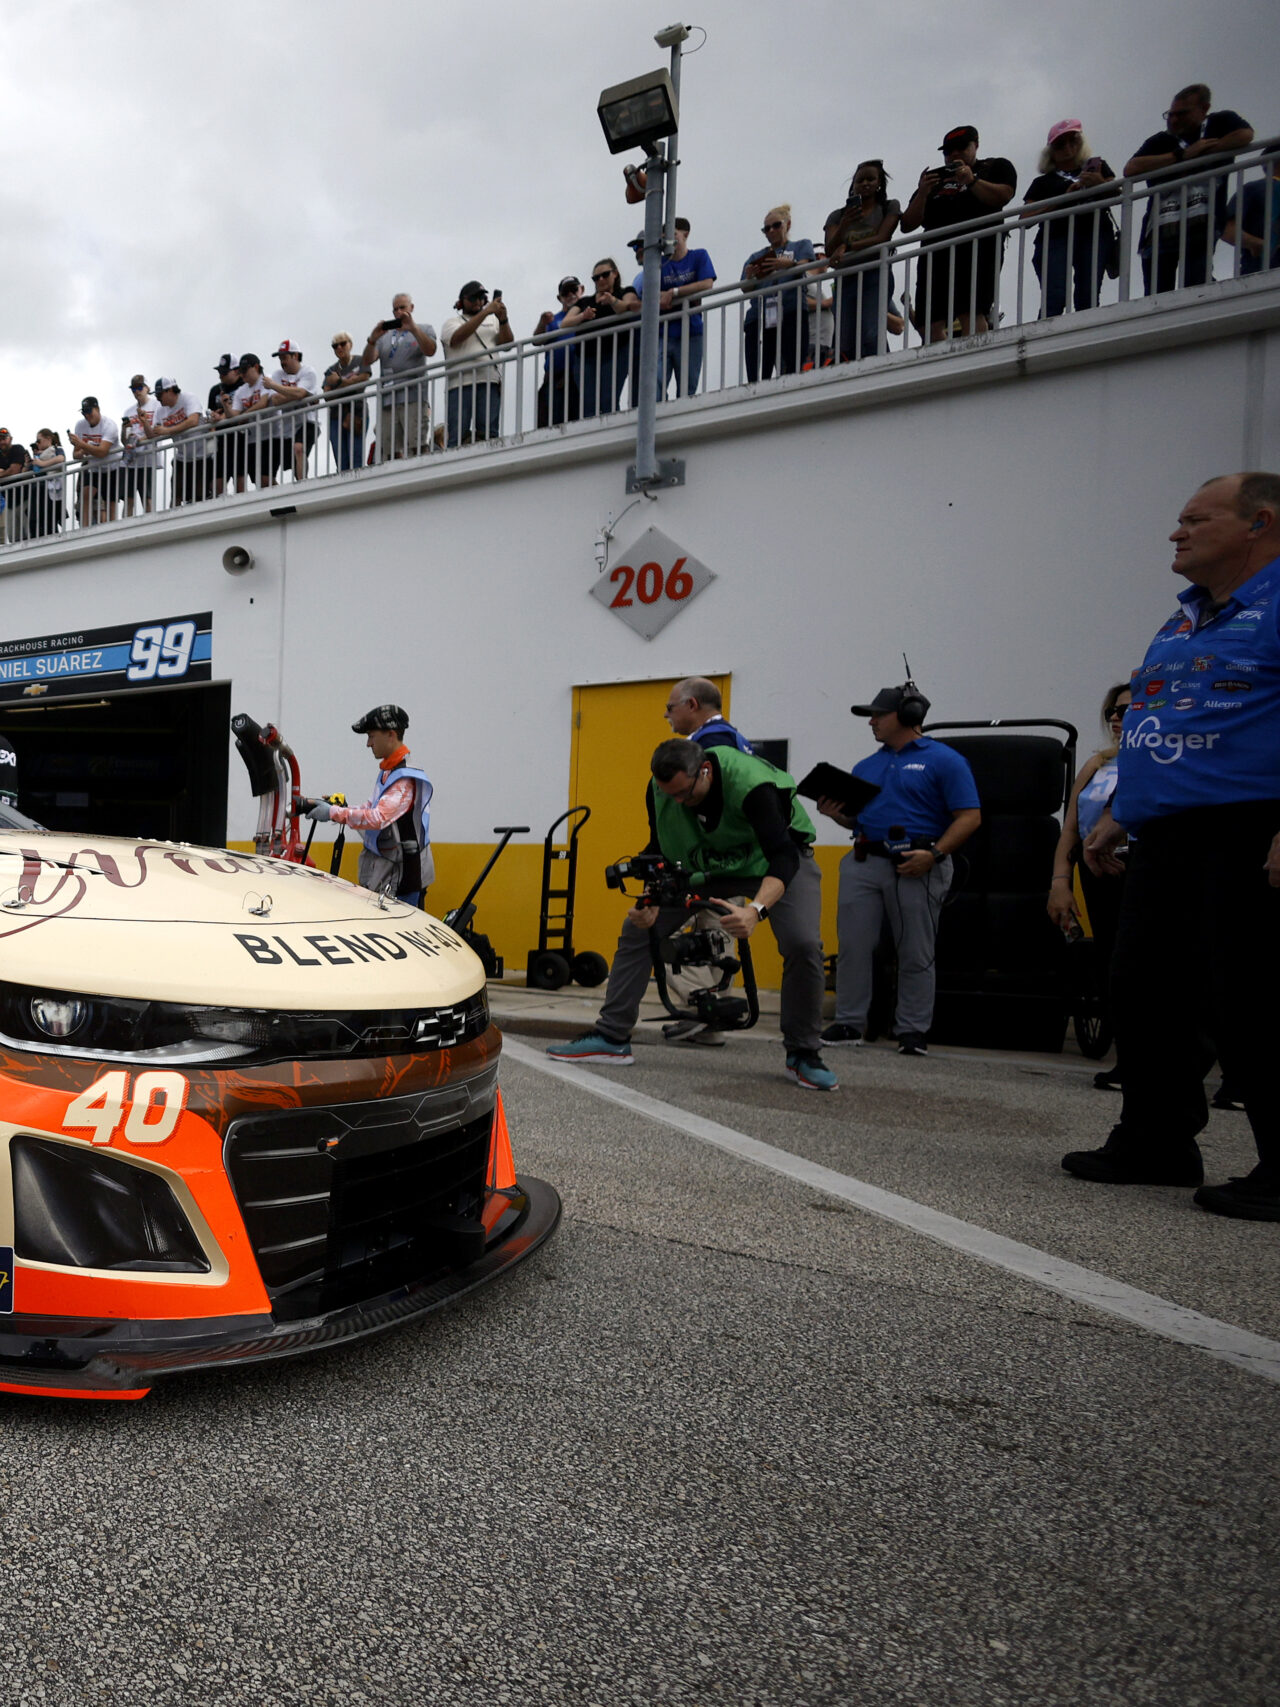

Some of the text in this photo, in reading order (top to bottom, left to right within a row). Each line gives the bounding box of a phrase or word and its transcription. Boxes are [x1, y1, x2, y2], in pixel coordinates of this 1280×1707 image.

[609, 557, 694, 608] 206
[50, 635, 84, 648] RACING
[126, 620, 198, 682] 99
[1202, 699, 1243, 711] Allegra
[1125, 715, 1221, 765] Kroger
[233, 933, 408, 966] BLEND
[62, 1070, 190, 1147] 40
